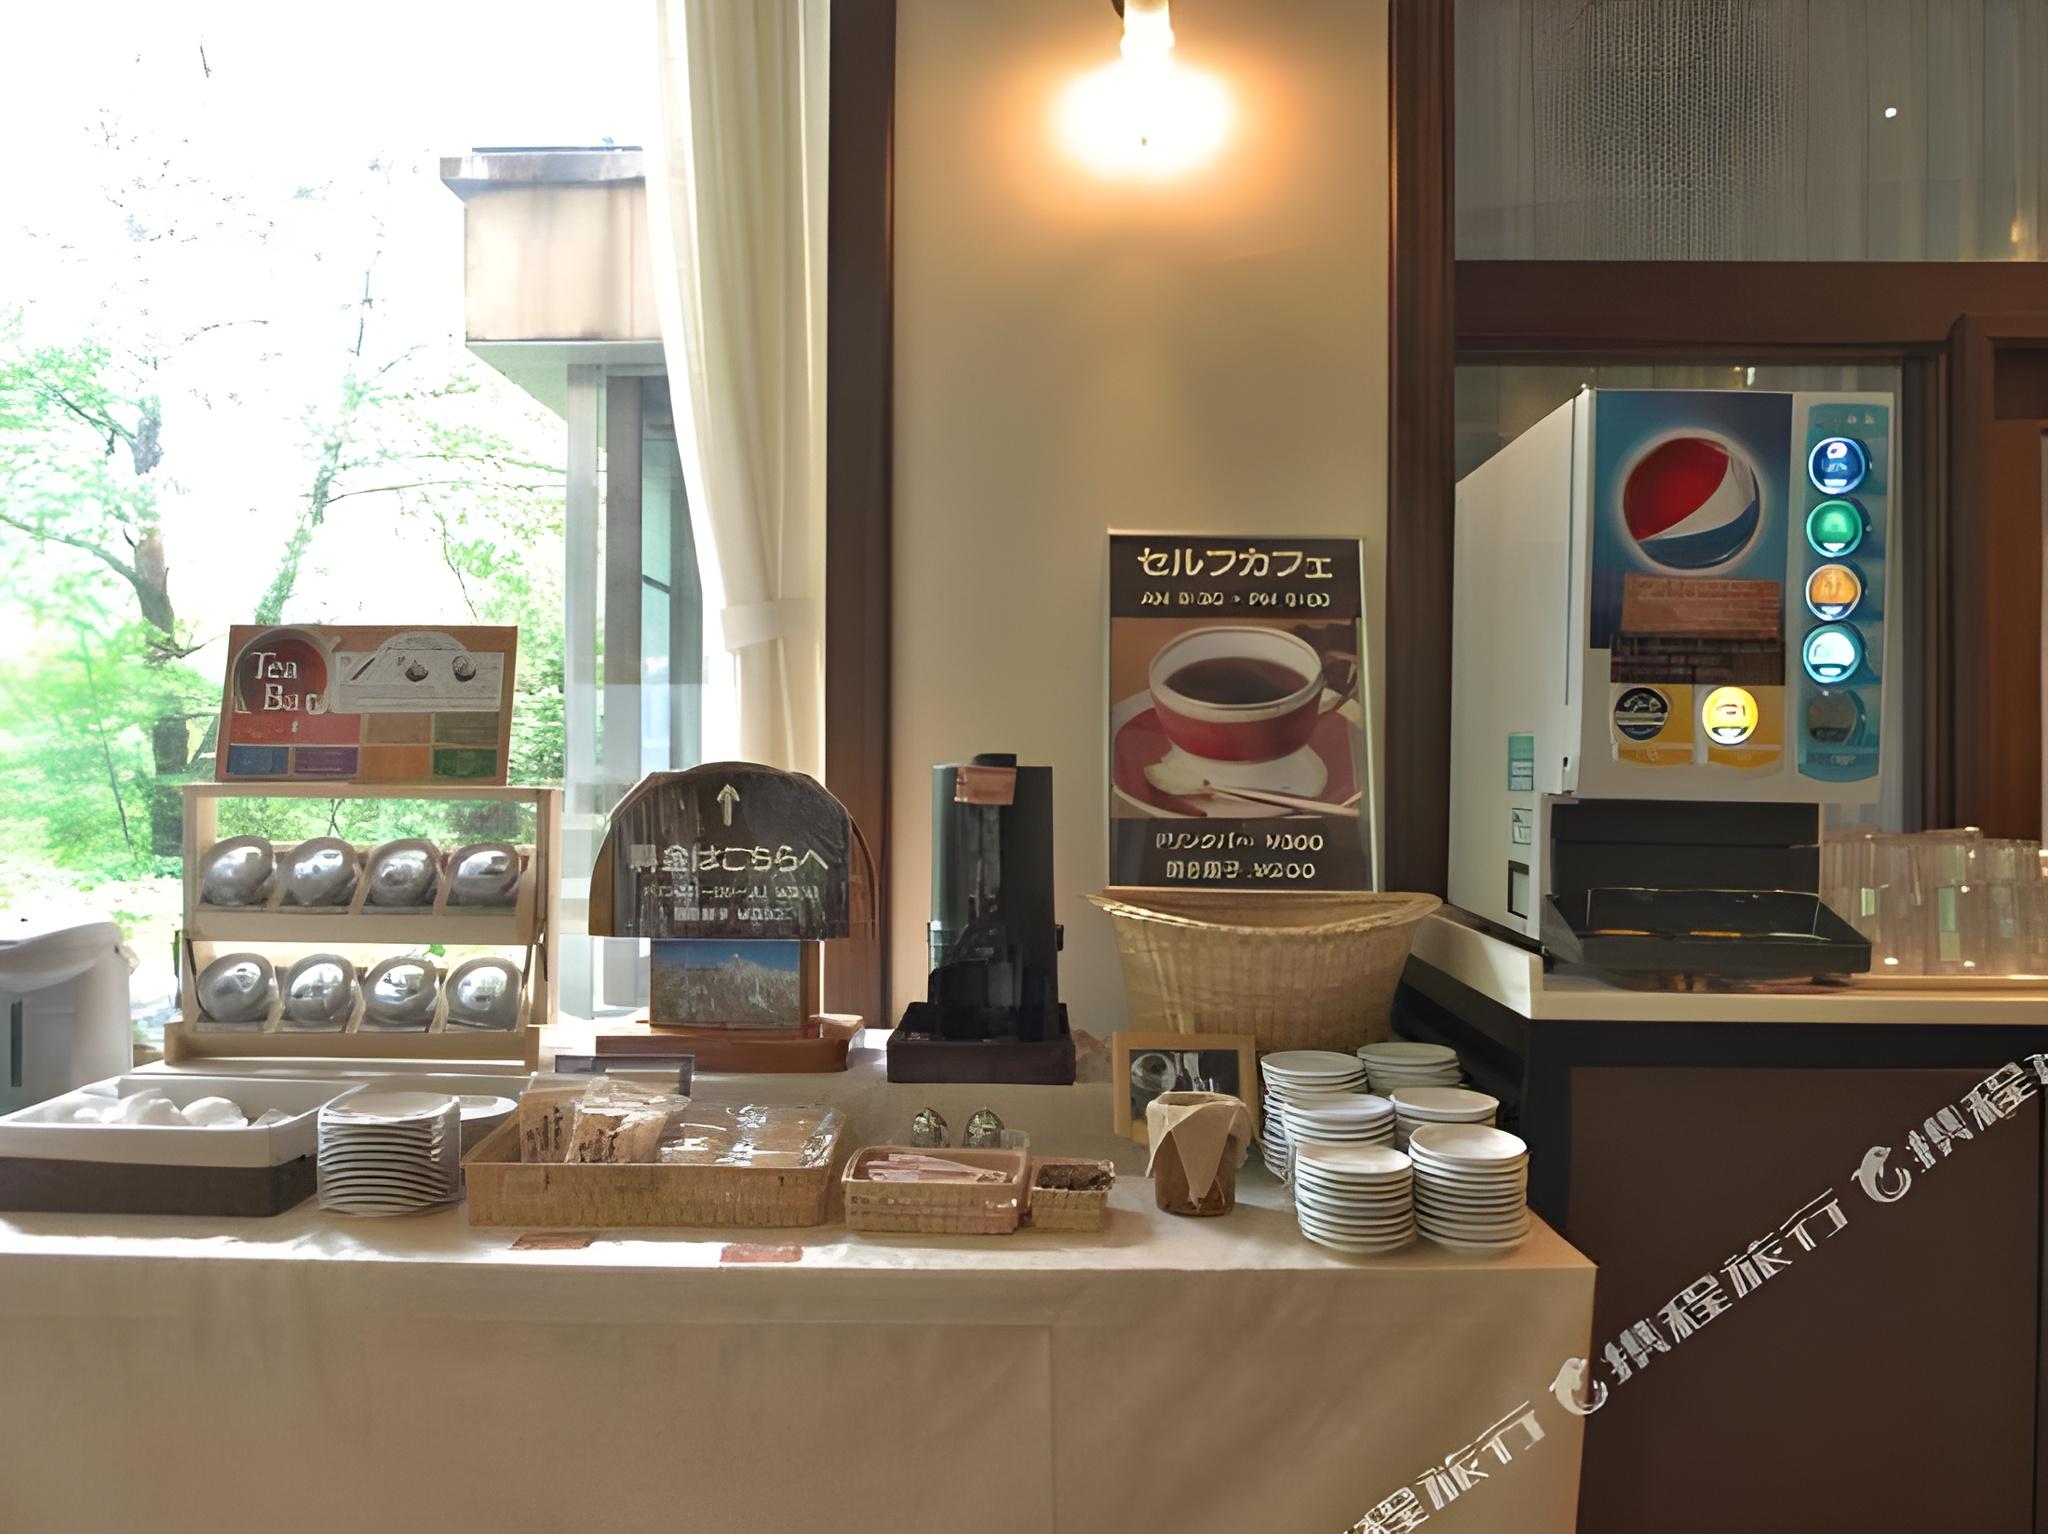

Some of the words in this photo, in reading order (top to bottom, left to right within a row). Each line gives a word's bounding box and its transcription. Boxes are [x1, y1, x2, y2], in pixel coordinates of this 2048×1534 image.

[1137, 547, 1333, 578] セルフカフェ
